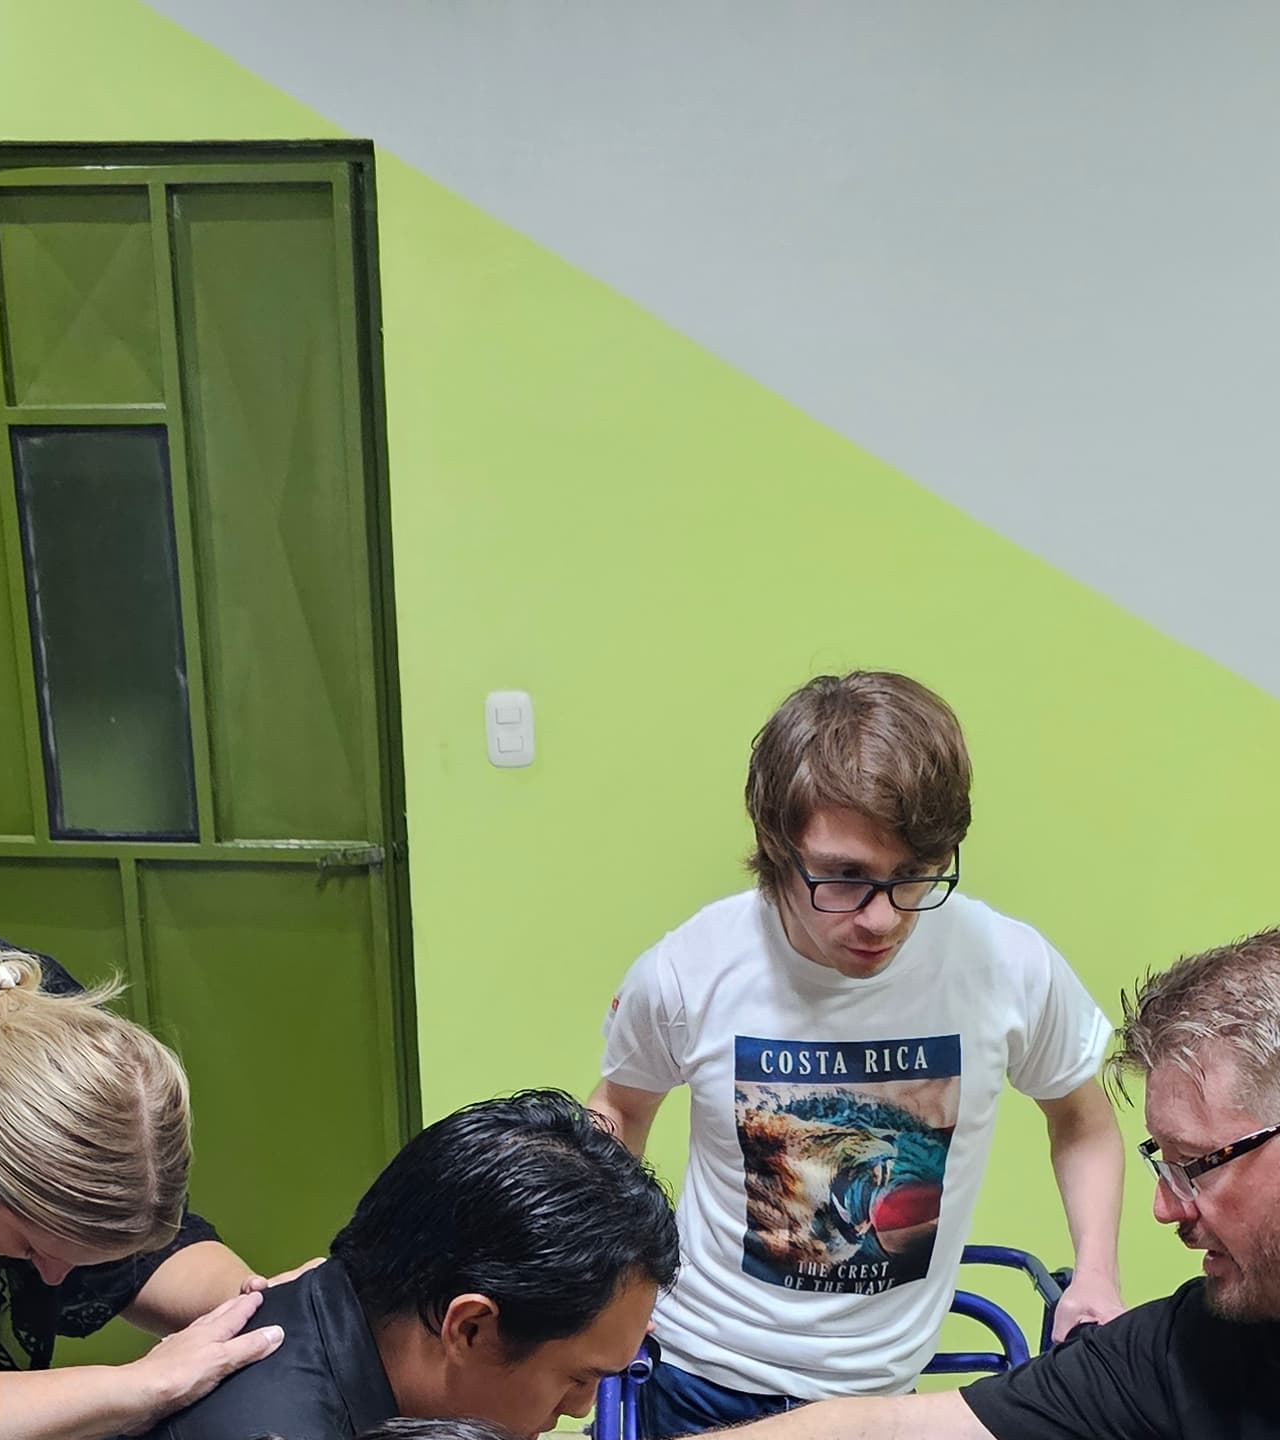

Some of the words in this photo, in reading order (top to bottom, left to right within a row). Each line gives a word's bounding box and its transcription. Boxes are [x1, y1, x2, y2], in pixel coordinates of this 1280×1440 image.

[760, 1050, 848, 1075] COSTA
[864, 1045, 928, 1073] RICA
[798, 1261, 828, 1278] THE
[837, 1261, 889, 1279] CREST
[784, 1275, 805, 1290] OF
[814, 1279, 845, 1293] THE
